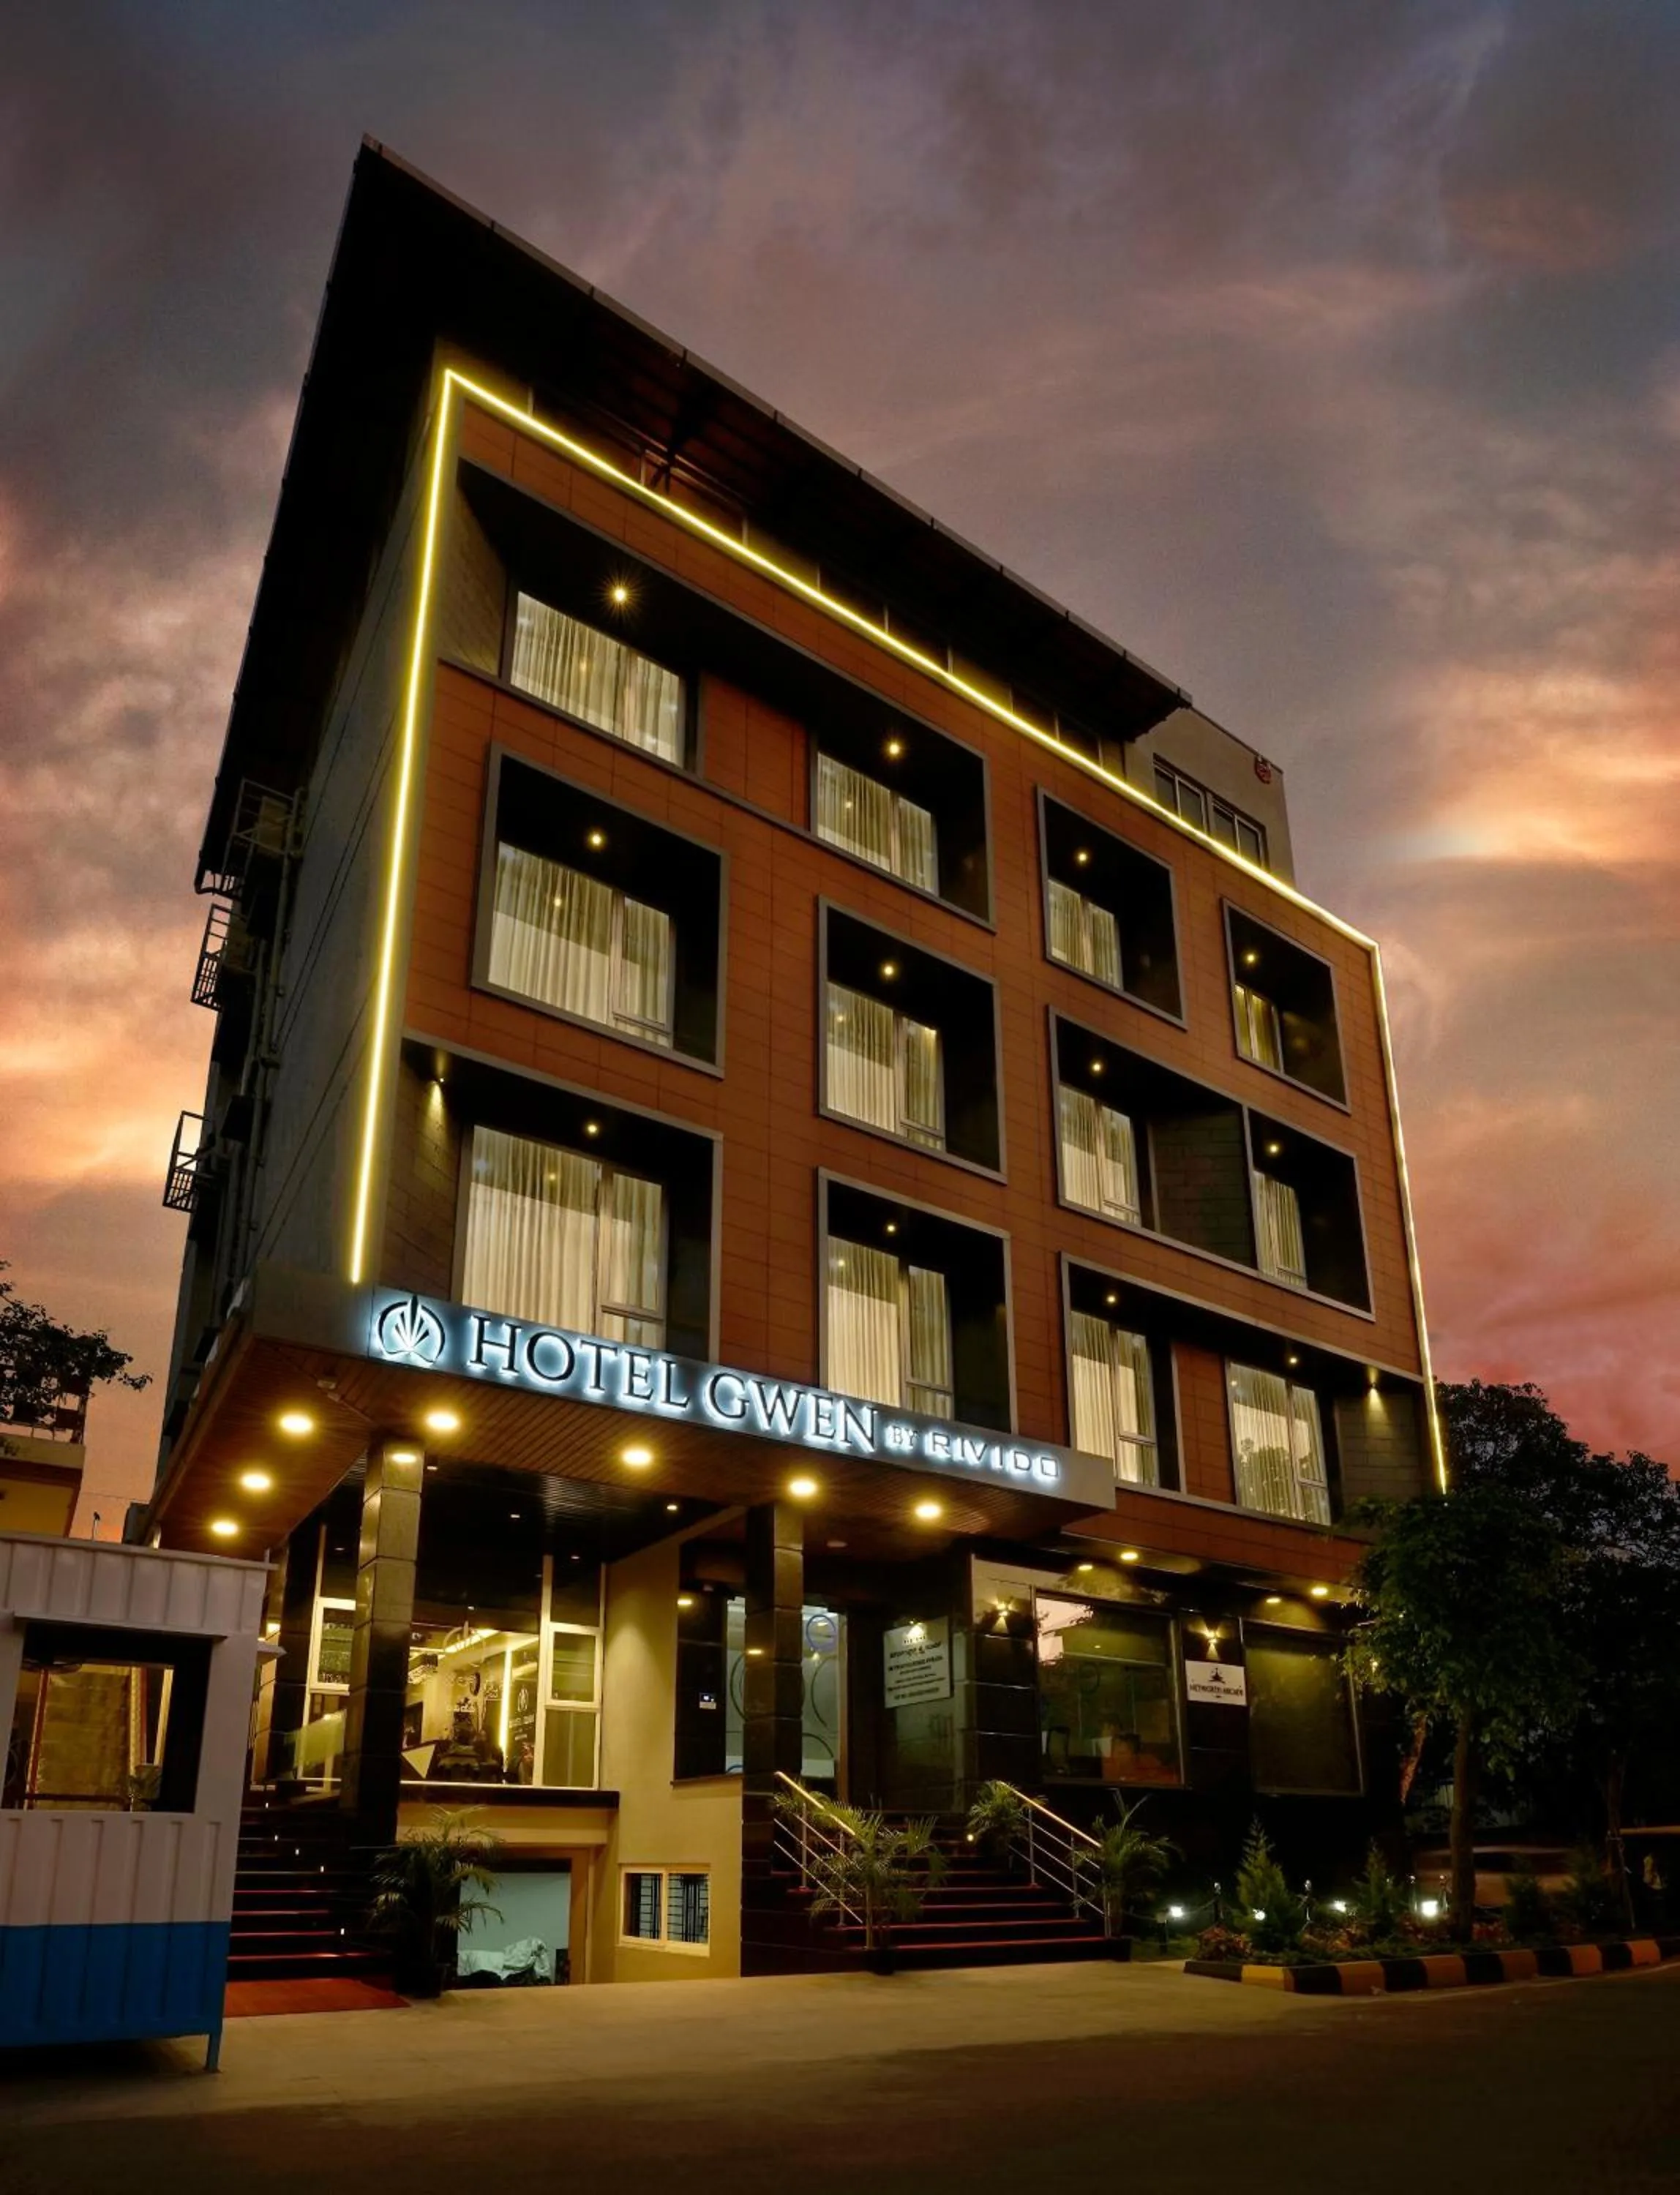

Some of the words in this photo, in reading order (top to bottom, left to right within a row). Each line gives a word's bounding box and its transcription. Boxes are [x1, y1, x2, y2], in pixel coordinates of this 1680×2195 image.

[468, 1315, 691, 1409] HOTEL
[708, 1372, 878, 1452] GWEN
[890, 1425, 917, 1448] BY
[931, 1431, 1060, 1477] RIVIDO
